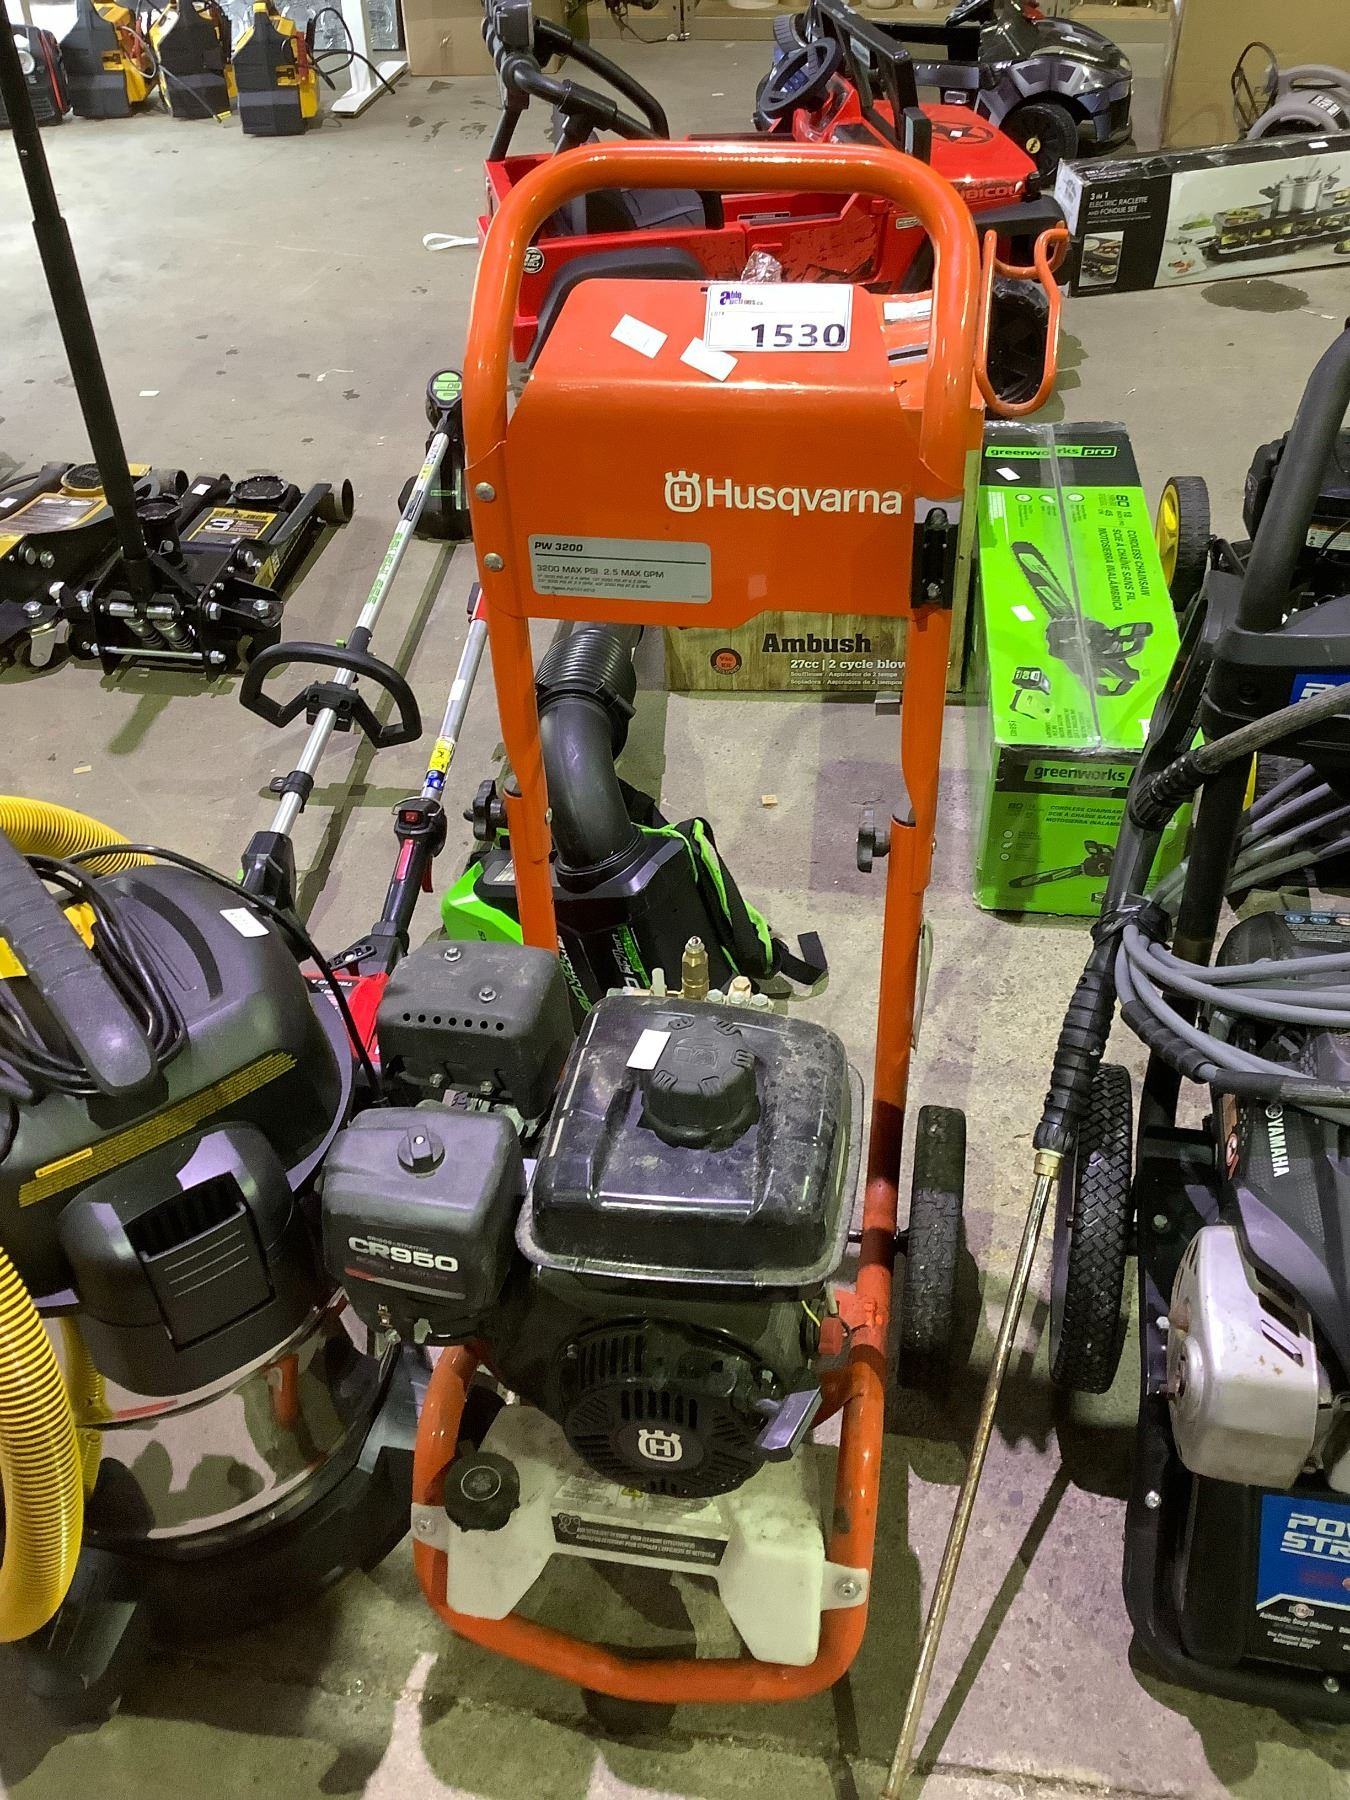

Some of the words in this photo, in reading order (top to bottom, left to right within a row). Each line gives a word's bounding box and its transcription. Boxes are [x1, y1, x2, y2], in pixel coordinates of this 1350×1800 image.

[1088, 199, 1118, 208] ELECTRIC
[1118, 196, 1149, 205] RACLETTE
[1089, 192, 1096, 200] 3
[1100, 206, 1127, 215] FONDUE
[1127, 205, 1138, 213] SET
[751, 323, 846, 348] 1530
[991, 447, 1079, 457] greenworks
[1083, 448, 1112, 457] pro
[706, 477, 902, 516] Husqvarna
[205, 518, 235, 530] 3
[534, 541, 553, 550] PW
[555, 542, 583, 552] 3200
[1098, 527, 1114, 563] MOTOSIERRA
[1127, 529, 1143, 560] CORDLESS
[536, 564, 560, 573] 3200
[562, 565, 583, 574] MAX
[584, 566, 599, 575] PSI
[620, 569, 641, 578] MAX
[643, 570, 665, 579] GPM
[1134, 560, 1150, 596] CHAINSAW
[1121, 572, 1132, 591] SANS
[762, 633, 872, 653] Ambush
[790, 659, 819, 669] 27cc
[828, 659, 837, 669] 2
[839, 659, 874, 671] cycle
[877, 659, 906, 669] blow
[1034, 766, 1126, 782] greenworks
[1267, 1117, 1290, 1178] YAMAHA
[348, 1236, 459, 1272] CR950
